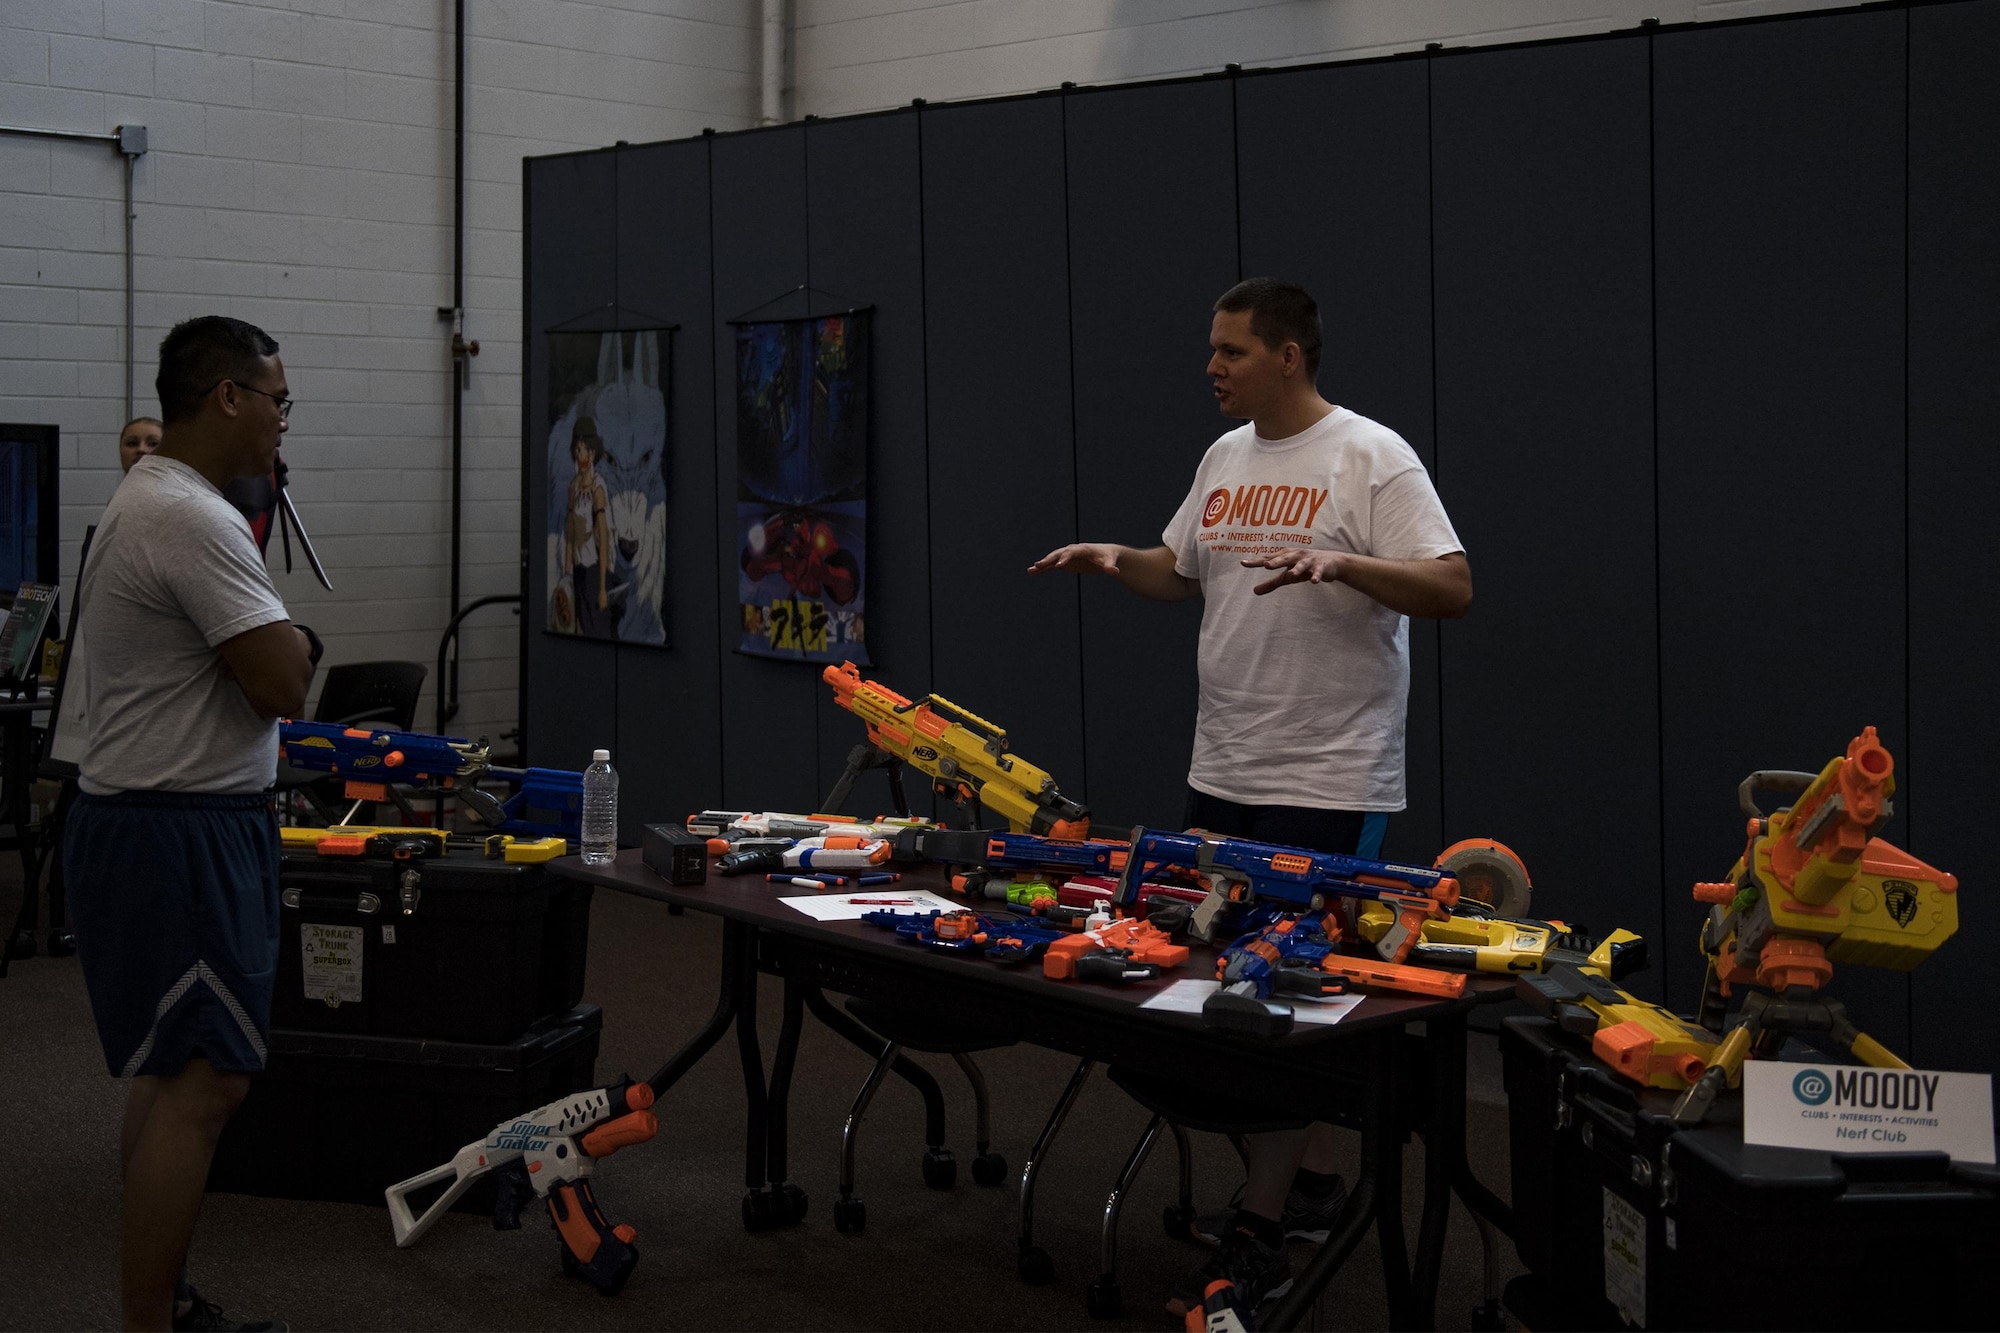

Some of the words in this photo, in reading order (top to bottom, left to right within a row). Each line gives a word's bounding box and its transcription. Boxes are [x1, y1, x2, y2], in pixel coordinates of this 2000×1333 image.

[1200, 531, 1218, 542] CLUBS
[1227, 532, 1264, 542] INTERESTS
[1269, 533, 1312, 544] ACTIVITIES
[912, 746, 937, 760] NERF
[353, 755, 380, 768] NERF
[313, 926, 355, 939] STORAGE
[319, 939, 349, 951] TRUNK
[1801, 1110, 1829, 1120] CLUBS
[1839, 1113, 1882, 1123] INTERESTS
[1891, 1116, 1939, 1127] ACTIVITIES
[500, 1120, 555, 1139] Super
[1836, 1127, 1867, 1139] Nerf
[1871, 1129, 1907, 1143] Club
[486, 1135, 552, 1151] Soaker
